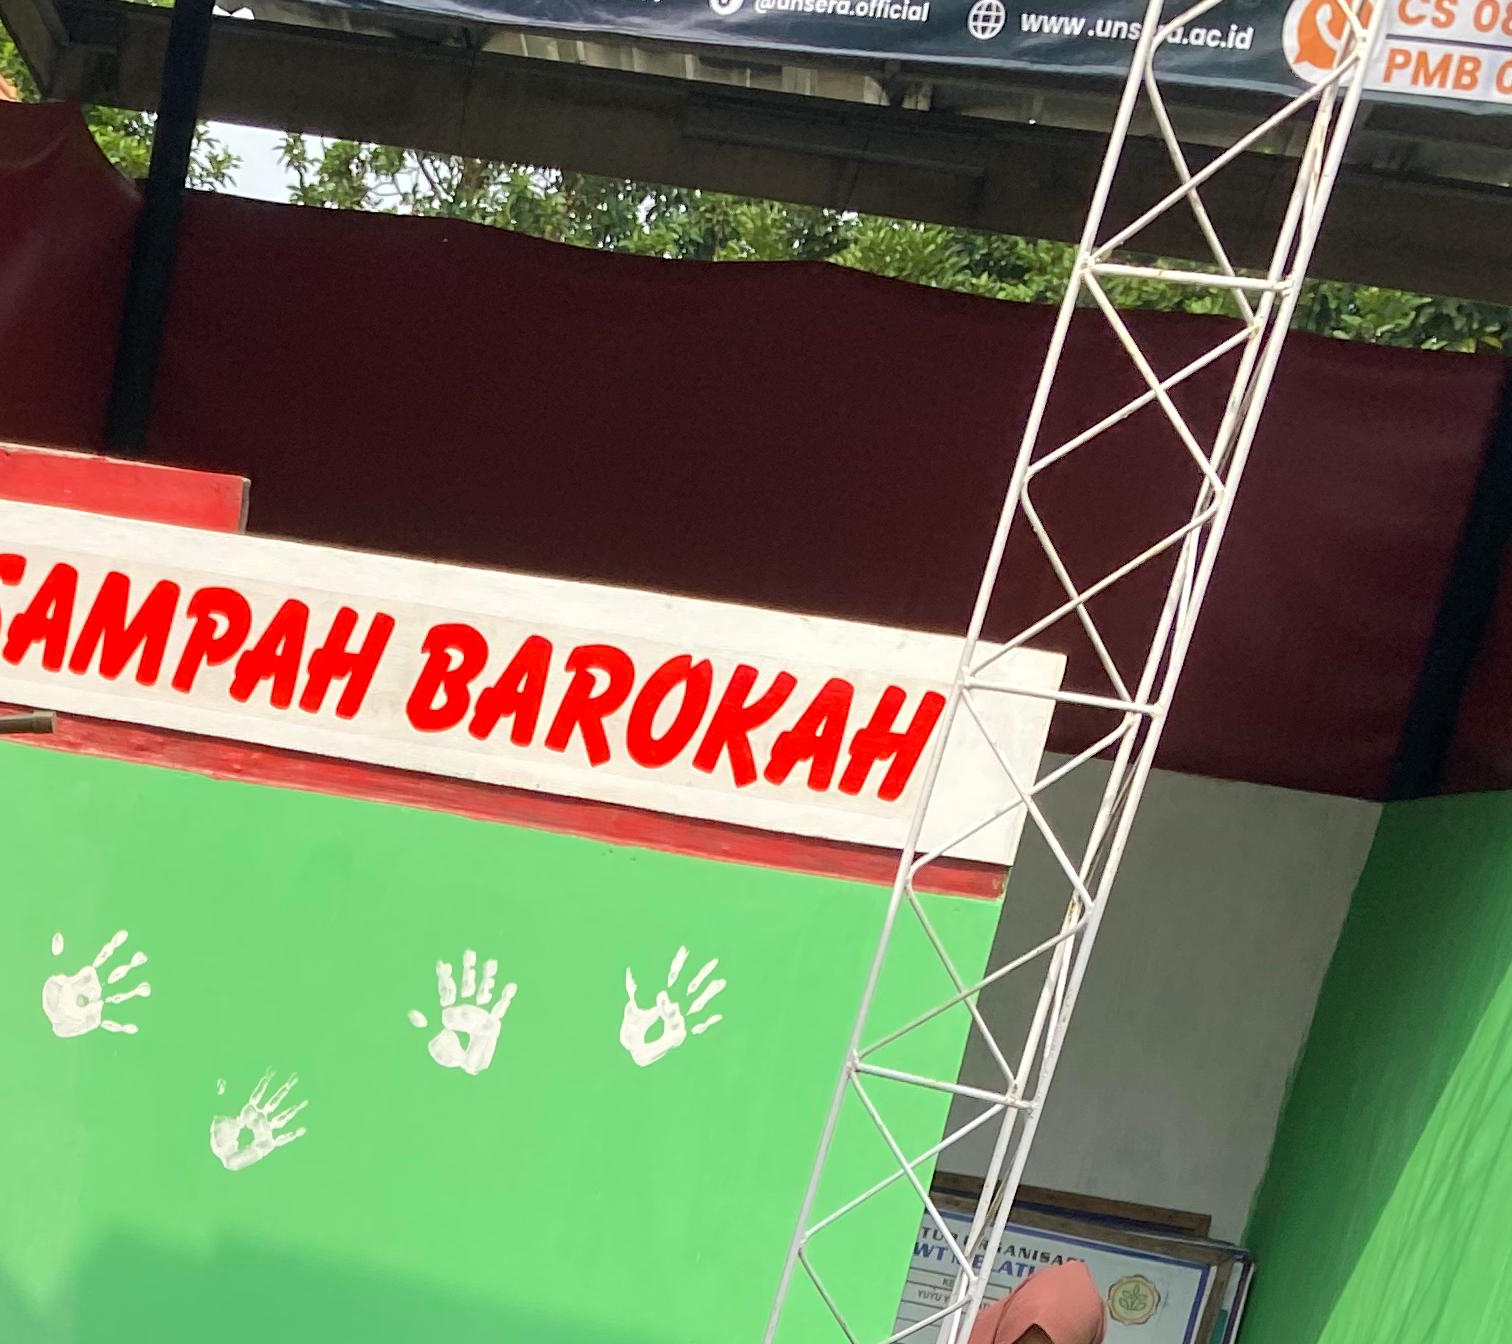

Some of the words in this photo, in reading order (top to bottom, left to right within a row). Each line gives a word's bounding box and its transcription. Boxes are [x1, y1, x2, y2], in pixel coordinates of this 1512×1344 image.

[1020, 12, 1255, 50] www.unsa.ac.id
[1383, 47, 1481, 91] PMB
[406, 623, 946, 801] BAROKAH
